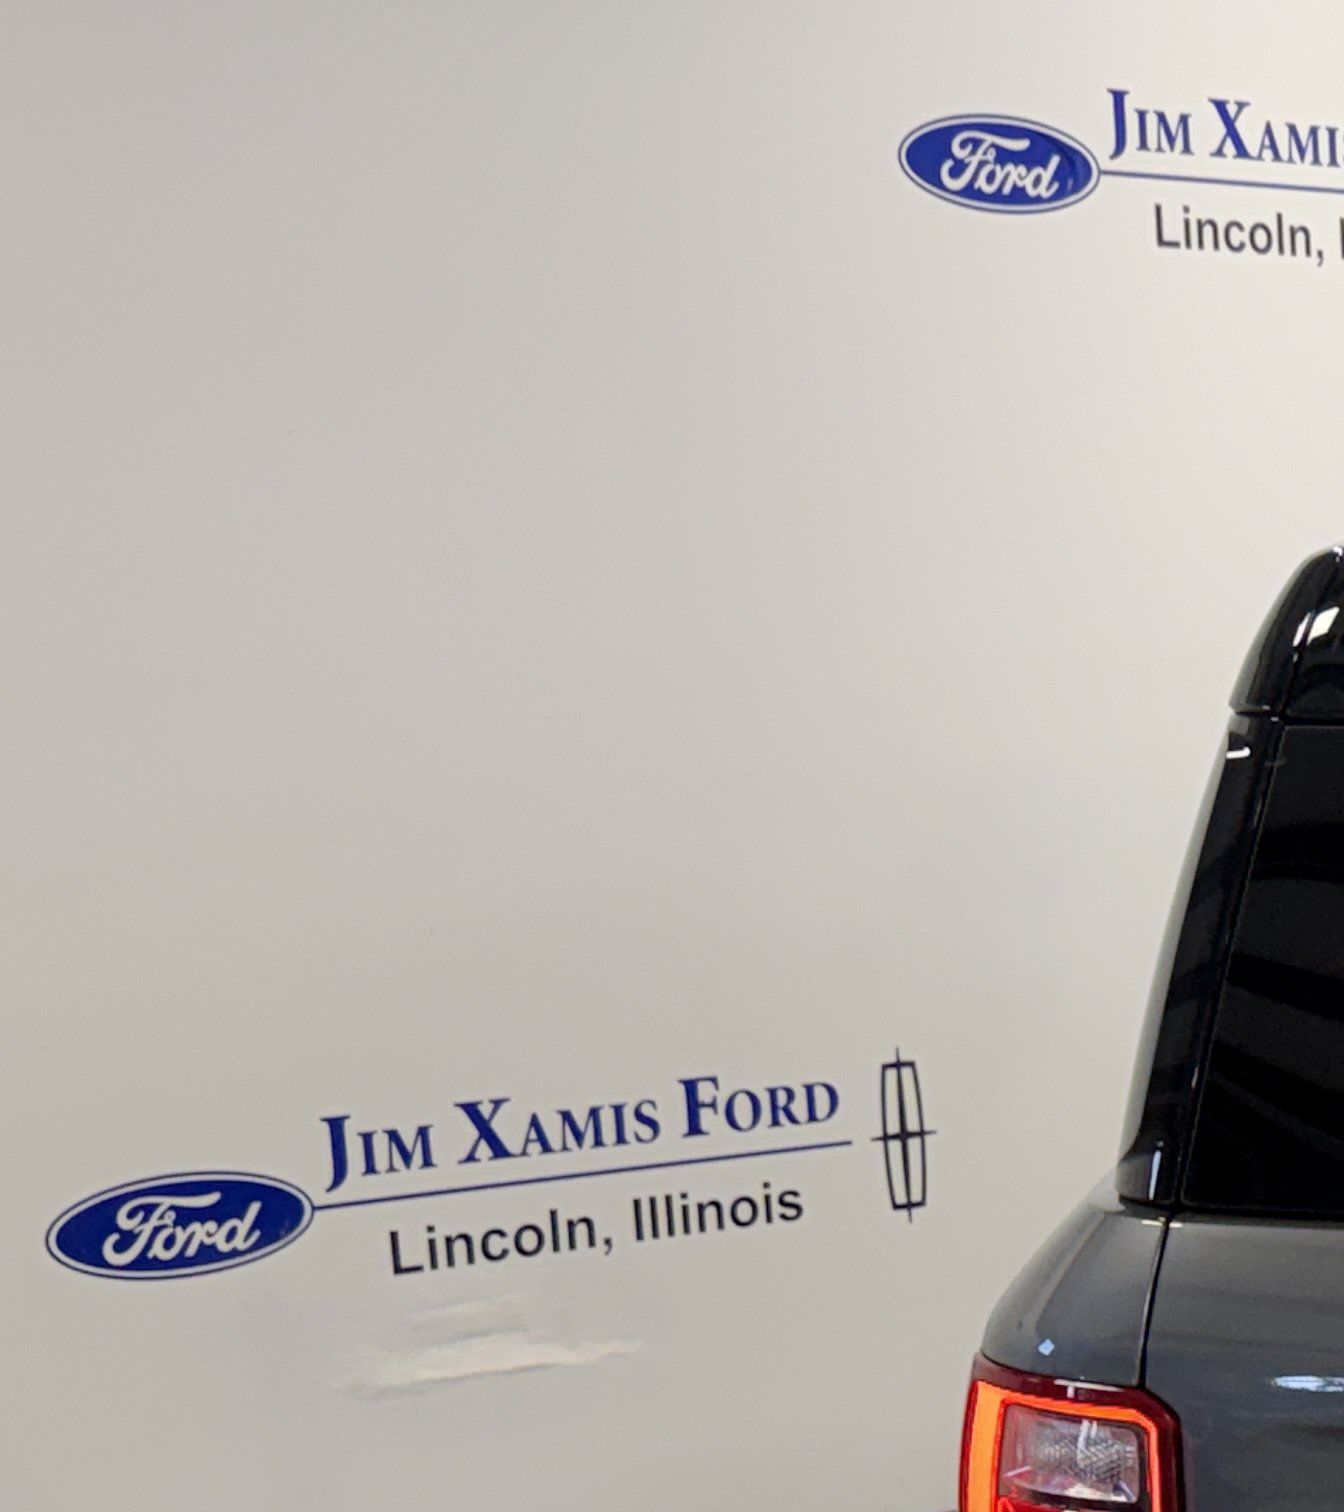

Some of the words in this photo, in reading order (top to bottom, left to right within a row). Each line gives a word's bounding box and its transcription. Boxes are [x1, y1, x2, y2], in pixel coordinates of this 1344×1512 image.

[1106, 87, 1194, 160] JIM
[940, 129, 1061, 200] Ford
[1153, 202, 1325, 268] Lincoln,
[320, 1114, 435, 1192] JIM
[454, 1097, 661, 1164] XAMIS
[677, 1075, 839, 1140] FORD
[101, 1191, 262, 1267] Ford
[388, 1208, 614, 1277] Lincoln,
[632, 1181, 804, 1243] Illinois
